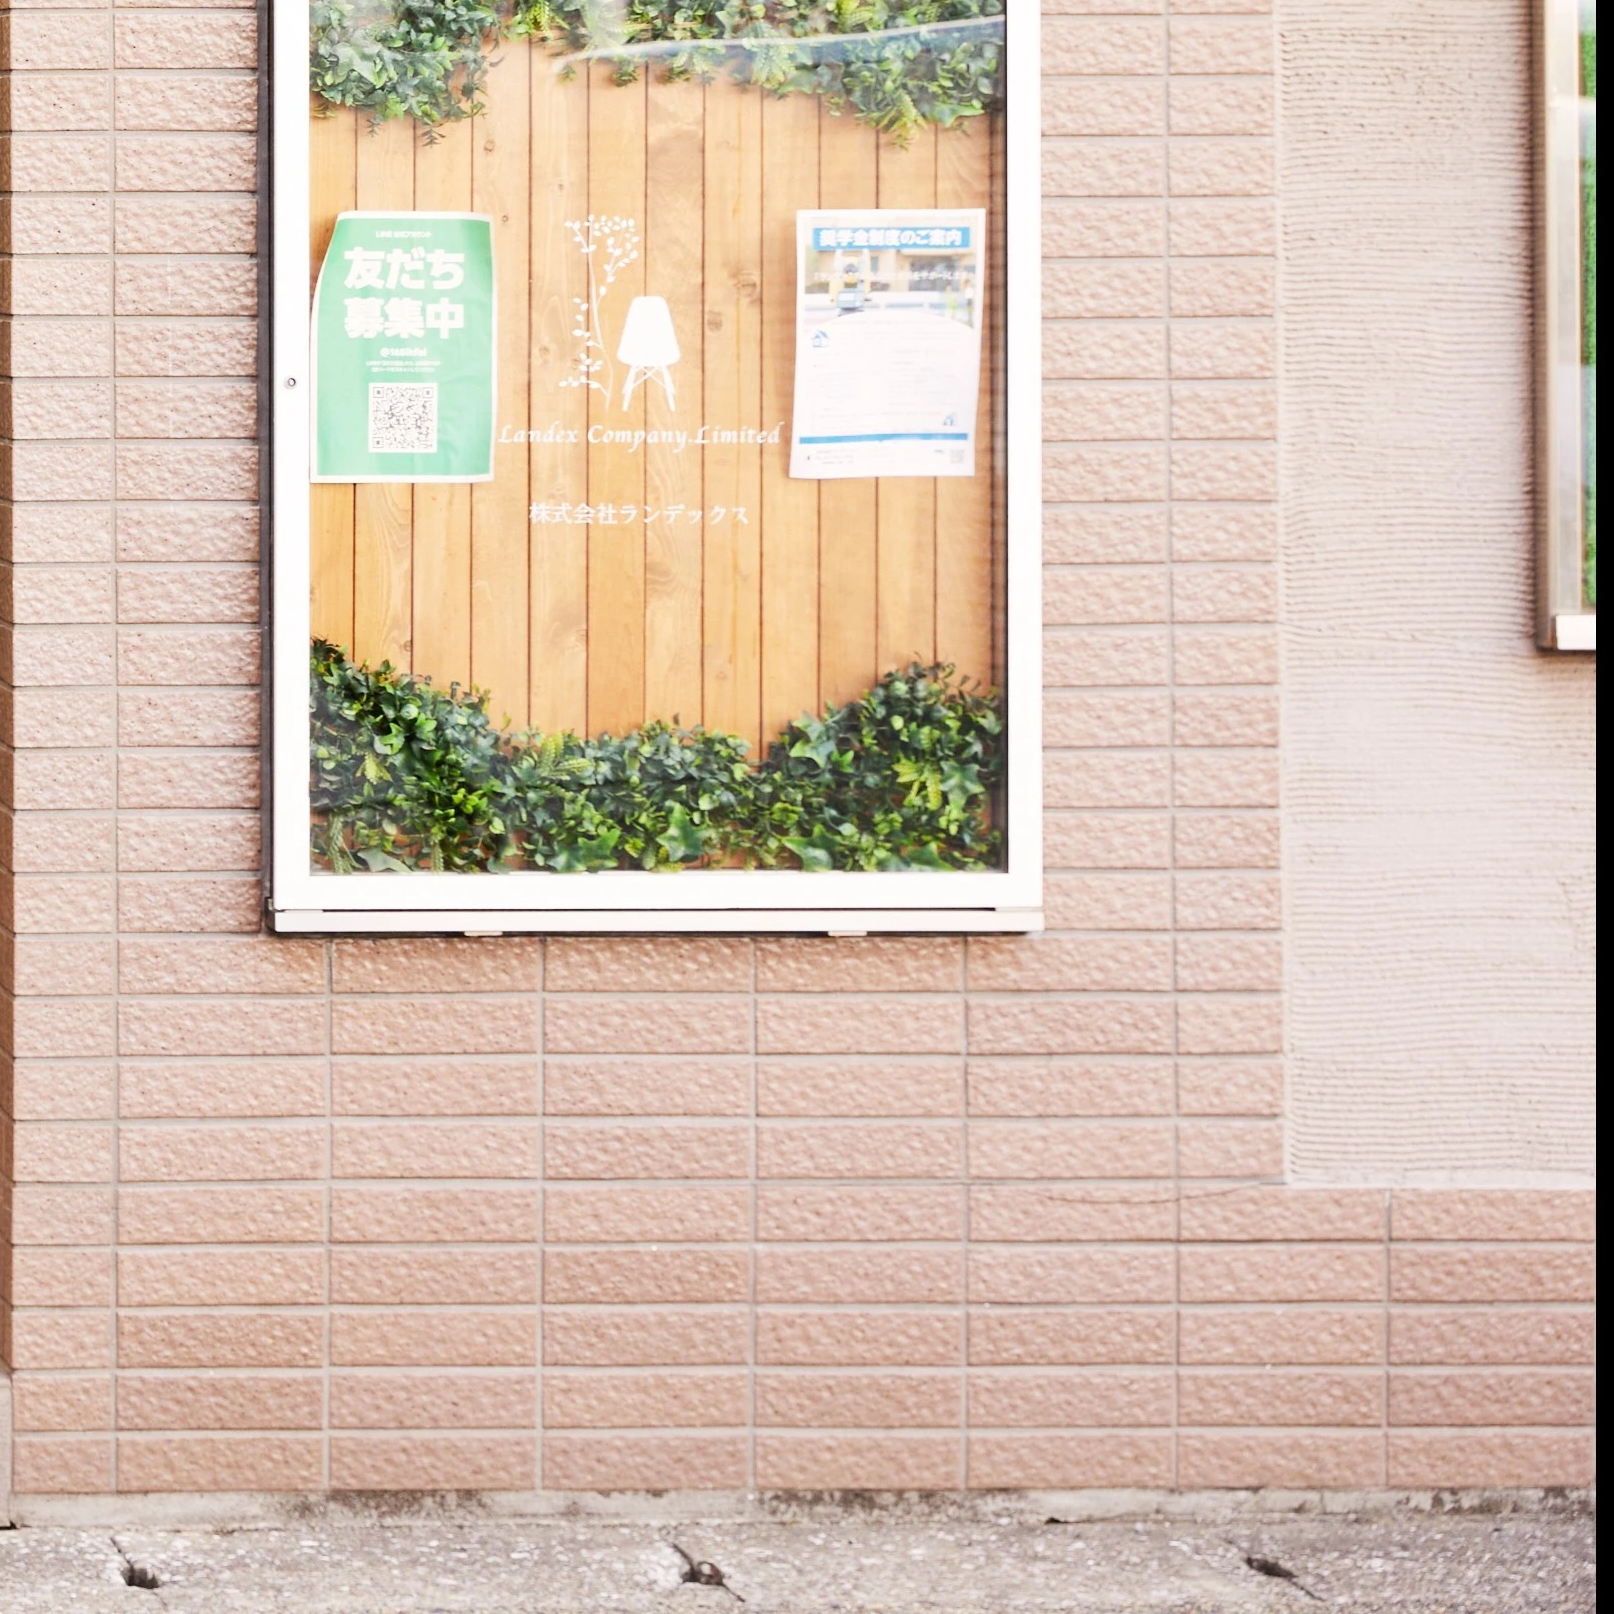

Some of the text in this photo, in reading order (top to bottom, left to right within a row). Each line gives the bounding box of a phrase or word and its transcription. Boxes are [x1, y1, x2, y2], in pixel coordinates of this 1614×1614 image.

[344, 246, 465, 291] 友だち
[344, 297, 465, 339] 募集中
[497, 420, 578, 445] Landex
[528, 501, 750, 526] 株式会社ランデックス
